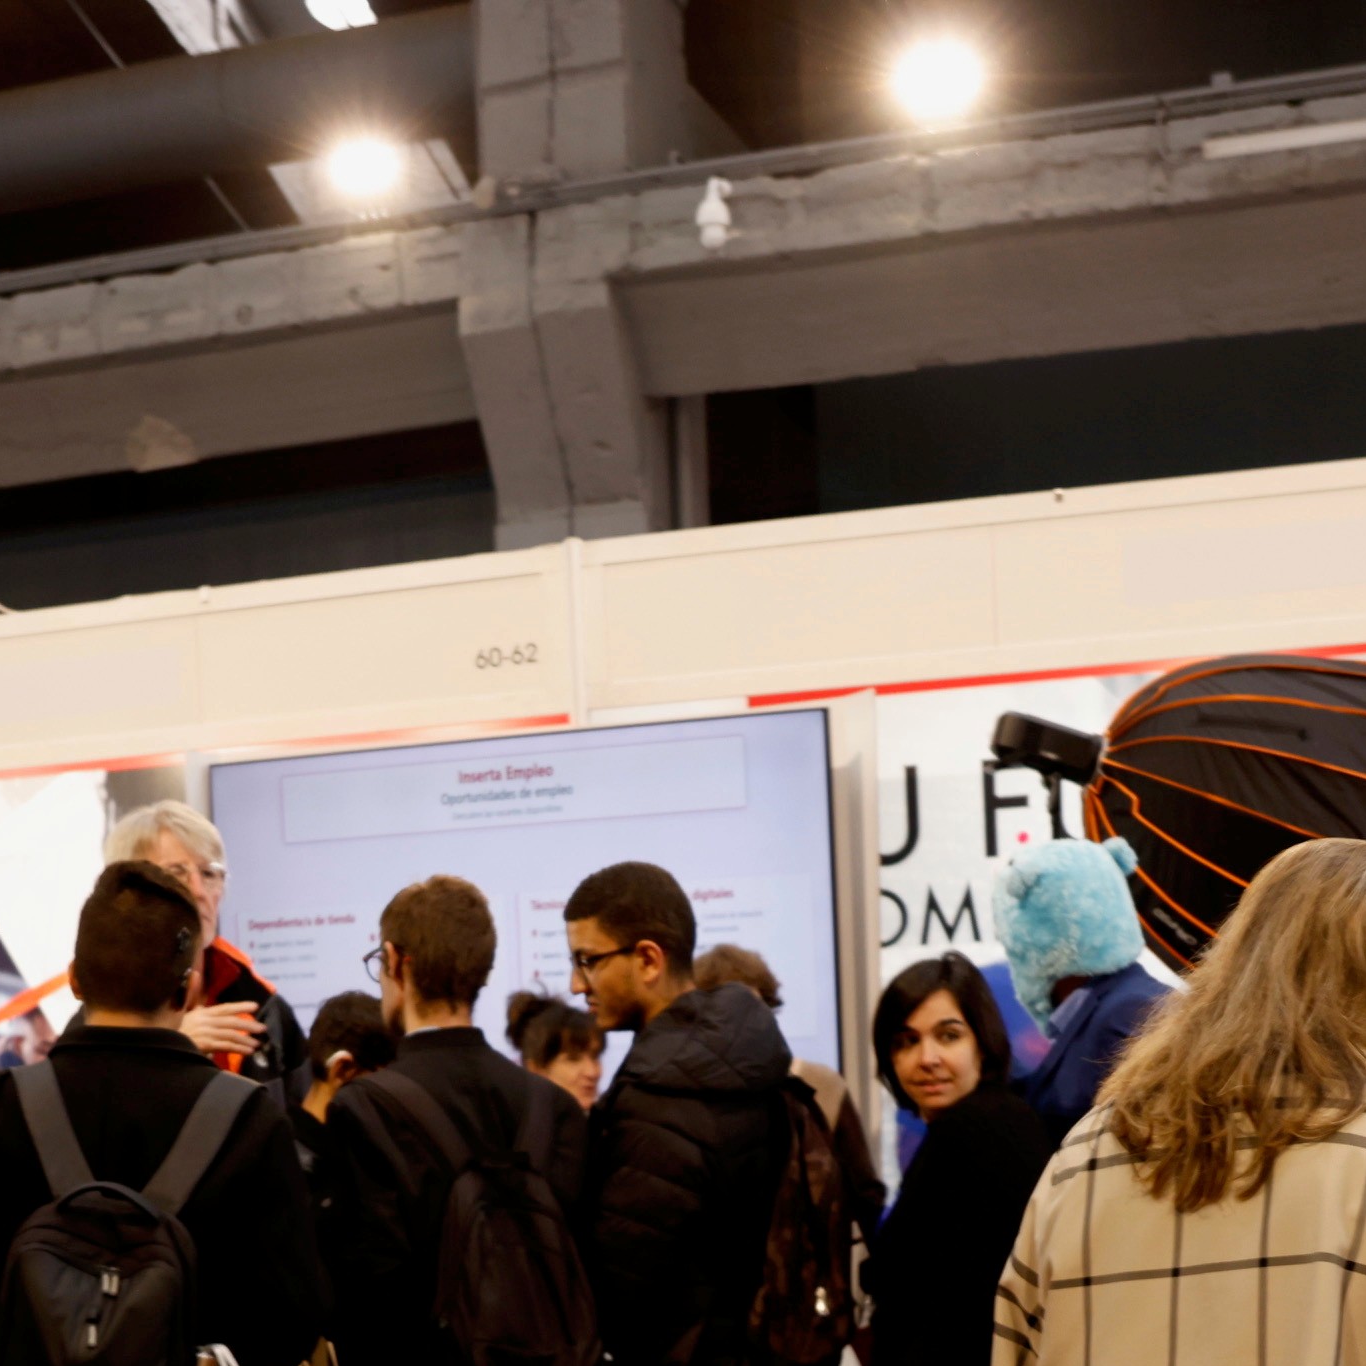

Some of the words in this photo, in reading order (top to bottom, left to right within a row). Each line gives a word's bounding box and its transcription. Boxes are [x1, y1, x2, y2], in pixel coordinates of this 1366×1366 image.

[476, 642, 538, 669] 60-62
[458, 769, 502, 784] Inserta
[505, 764, 554, 781] Empleo
